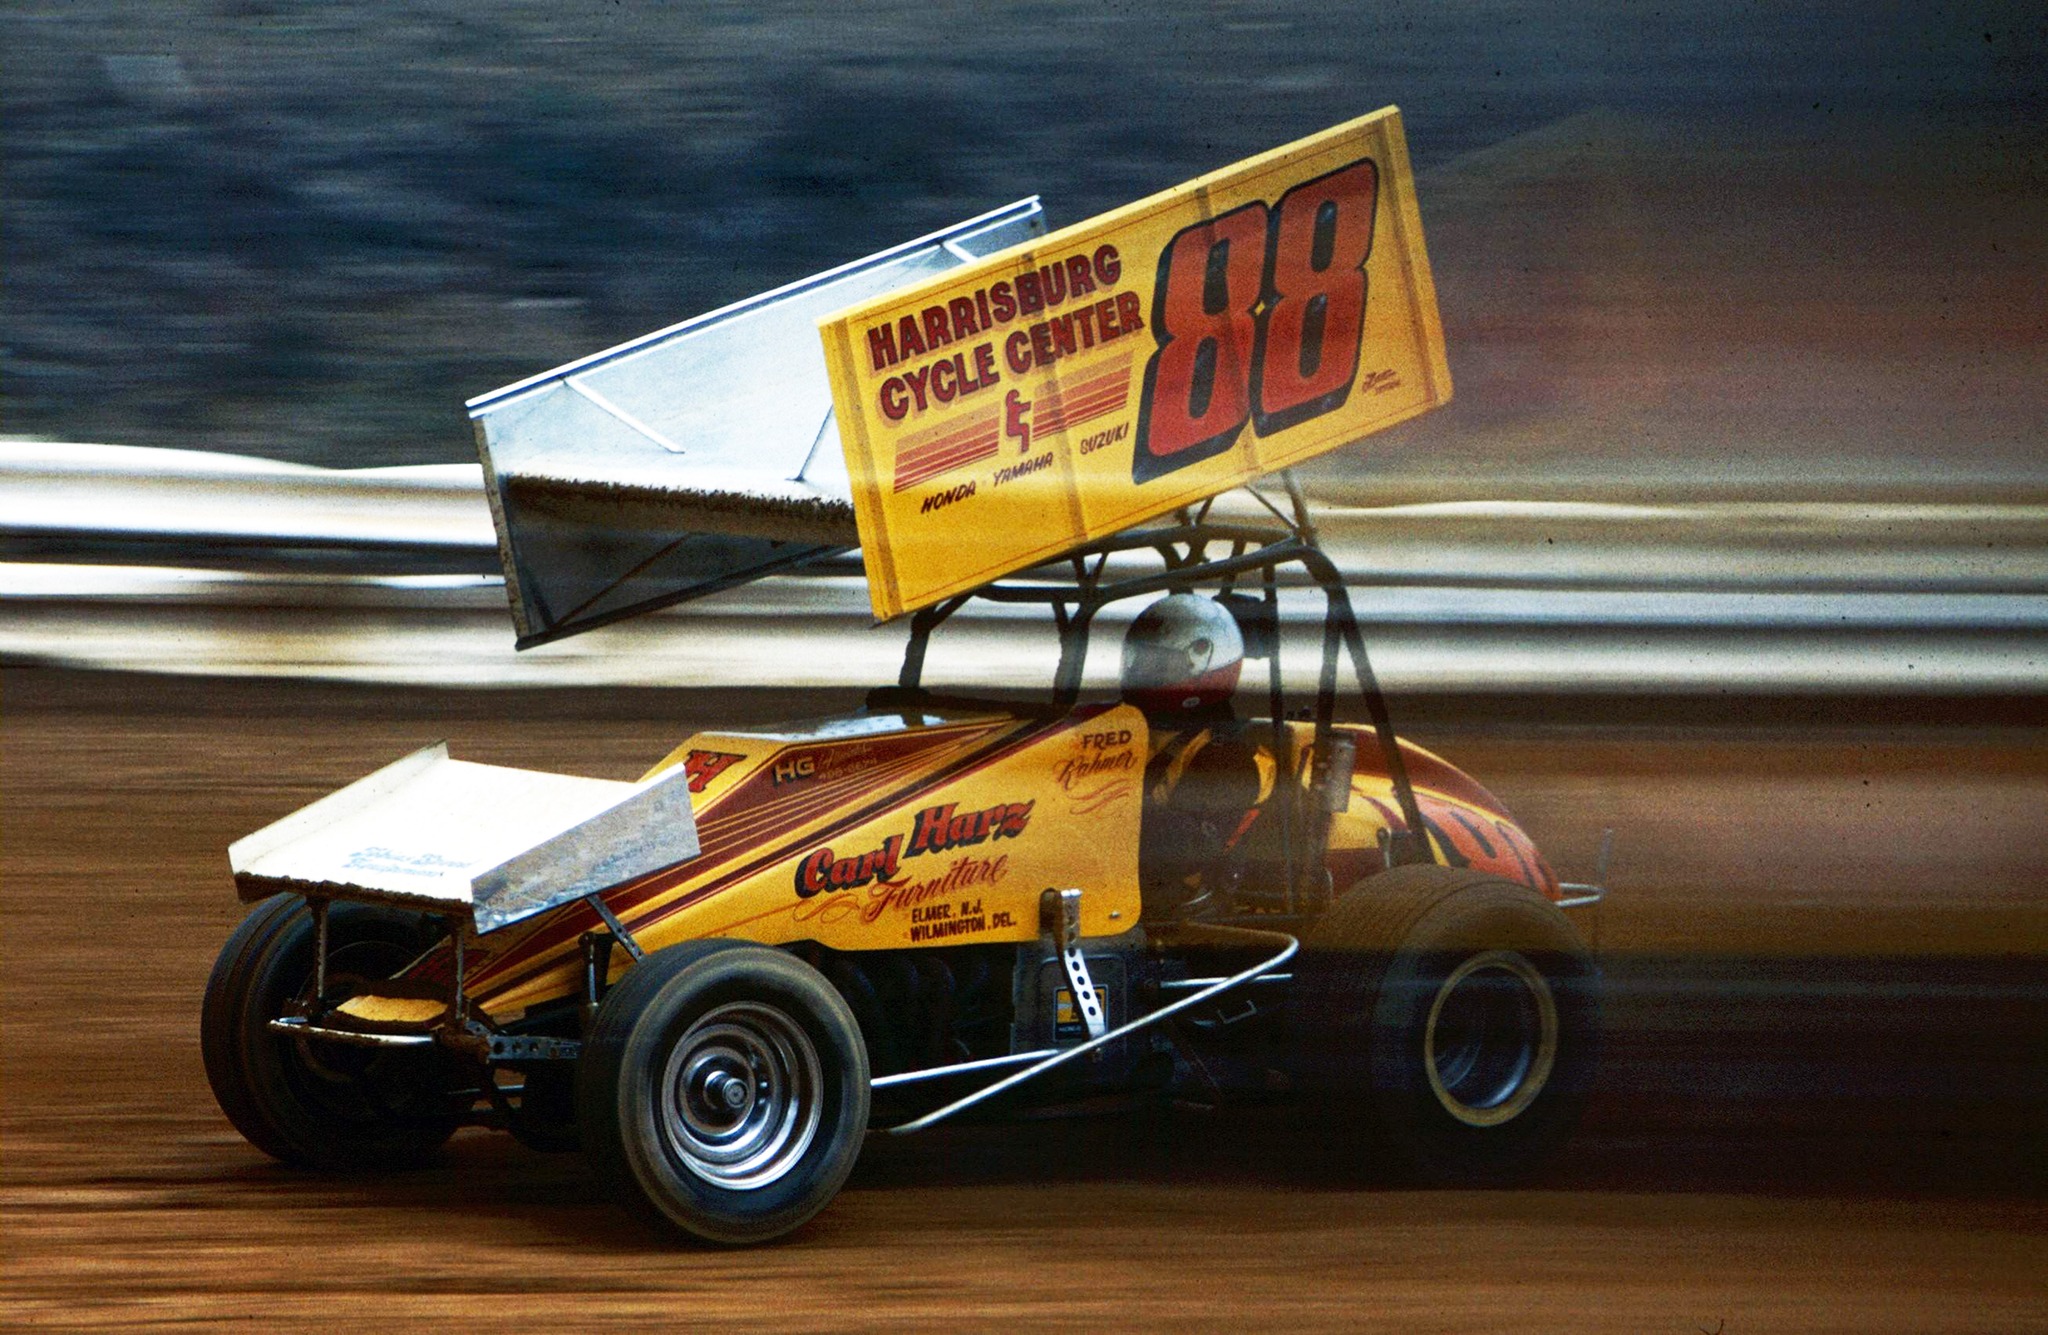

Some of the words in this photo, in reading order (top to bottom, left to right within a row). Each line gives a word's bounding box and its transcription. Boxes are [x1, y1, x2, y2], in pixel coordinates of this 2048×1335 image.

[867, 243, 1121, 371] HARRISBURG
[879, 342, 1000, 420] CYCLE
[1005, 290, 1145, 374] CENTER
[1132, 157, 1380, 485] 88
[920, 481, 976, 514] HONDA
[993, 451, 1054, 487] YAMAHA
[1080, 422, 1130, 455] SUZUKI
[1082, 729, 1132, 751] FRED
[794, 833, 905, 899] Carl
[902, 798, 1036, 859] Harz
[862, 853, 1009, 924] Furniture
